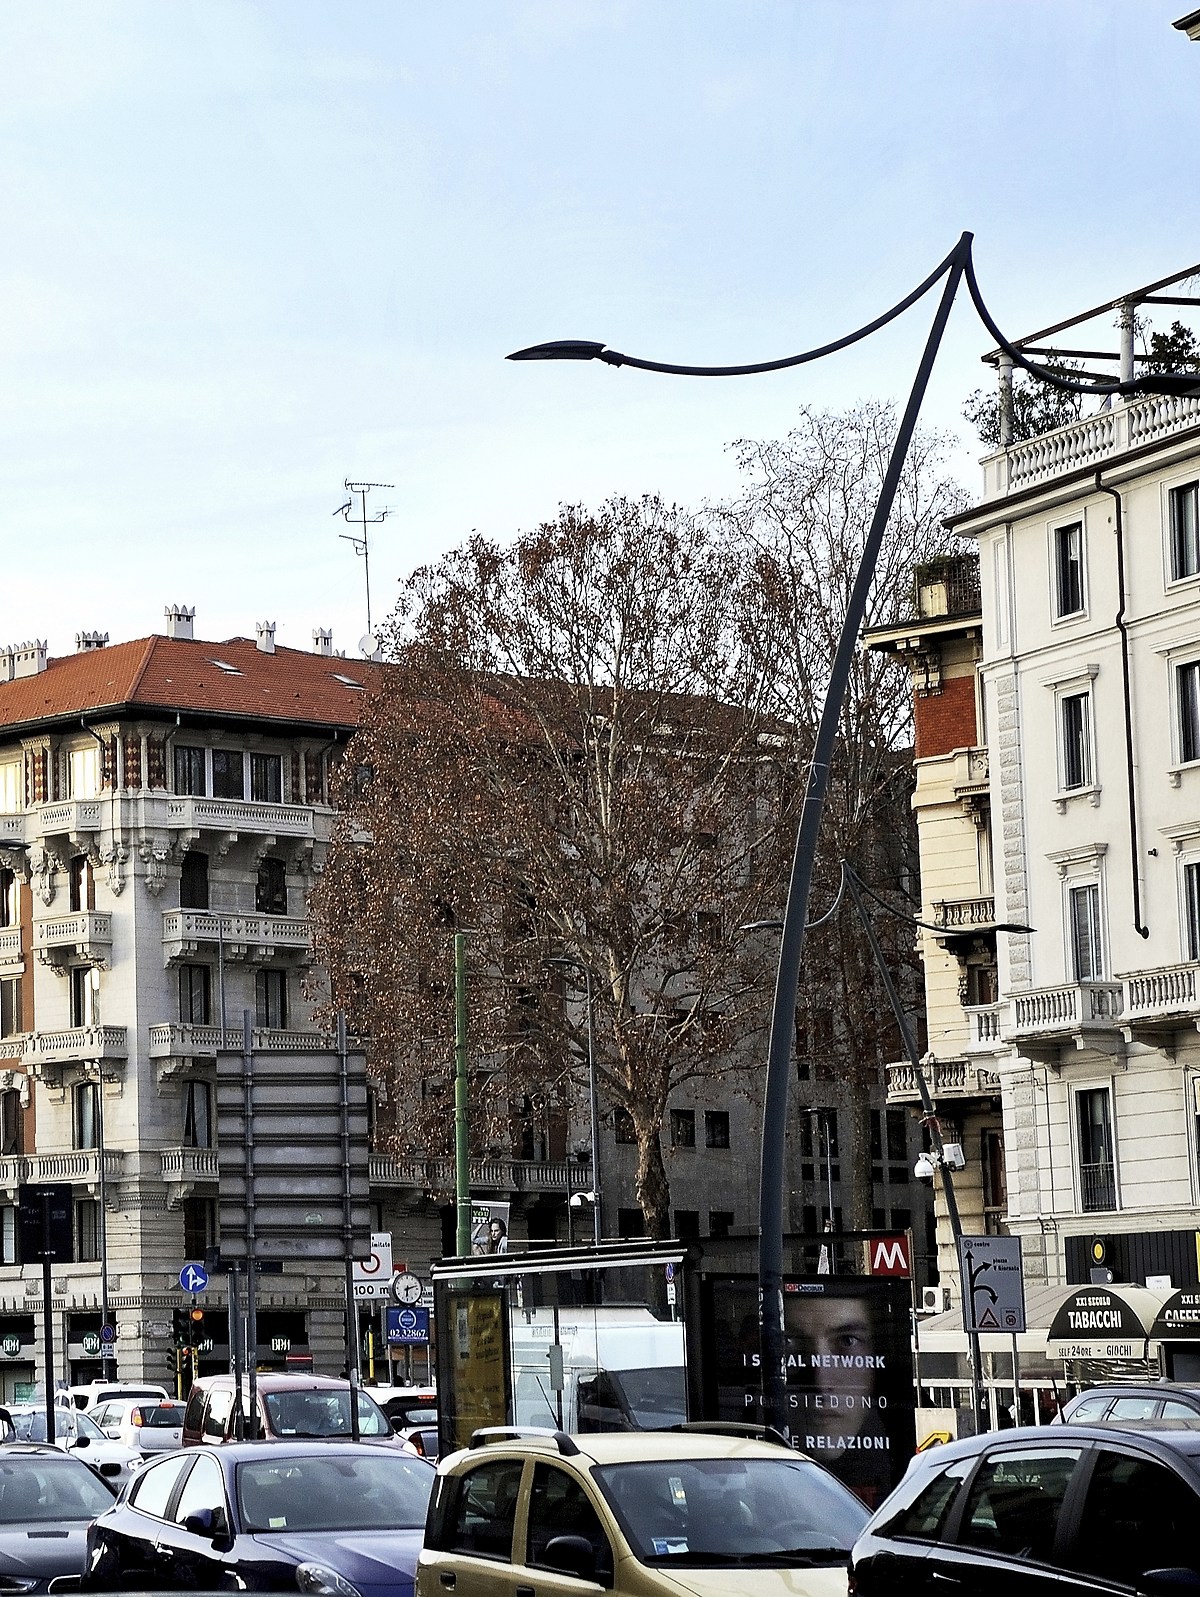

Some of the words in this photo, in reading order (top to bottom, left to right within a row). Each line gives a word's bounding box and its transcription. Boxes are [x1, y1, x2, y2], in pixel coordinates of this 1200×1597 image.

[873, 1242, 907, 1269] M
[354, 1285, 374, 1295] 100
[1076, 1297, 1088, 1306] XXI
[1088, 1296, 1111, 1306] SECOLO
[1181, 1294, 1193, 1304] XXI
[1194, 1295, 1200, 1304] S
[1068, 1310, 1122, 1328] TABACCHI
[1059, 1348, 1070, 1357] SELF
[1106, 1345, 1132, 1356] GIOCHI
[811, 1354, 886, 1368] NETWORK
[806, 1436, 890, 1450] RELAZIONI
